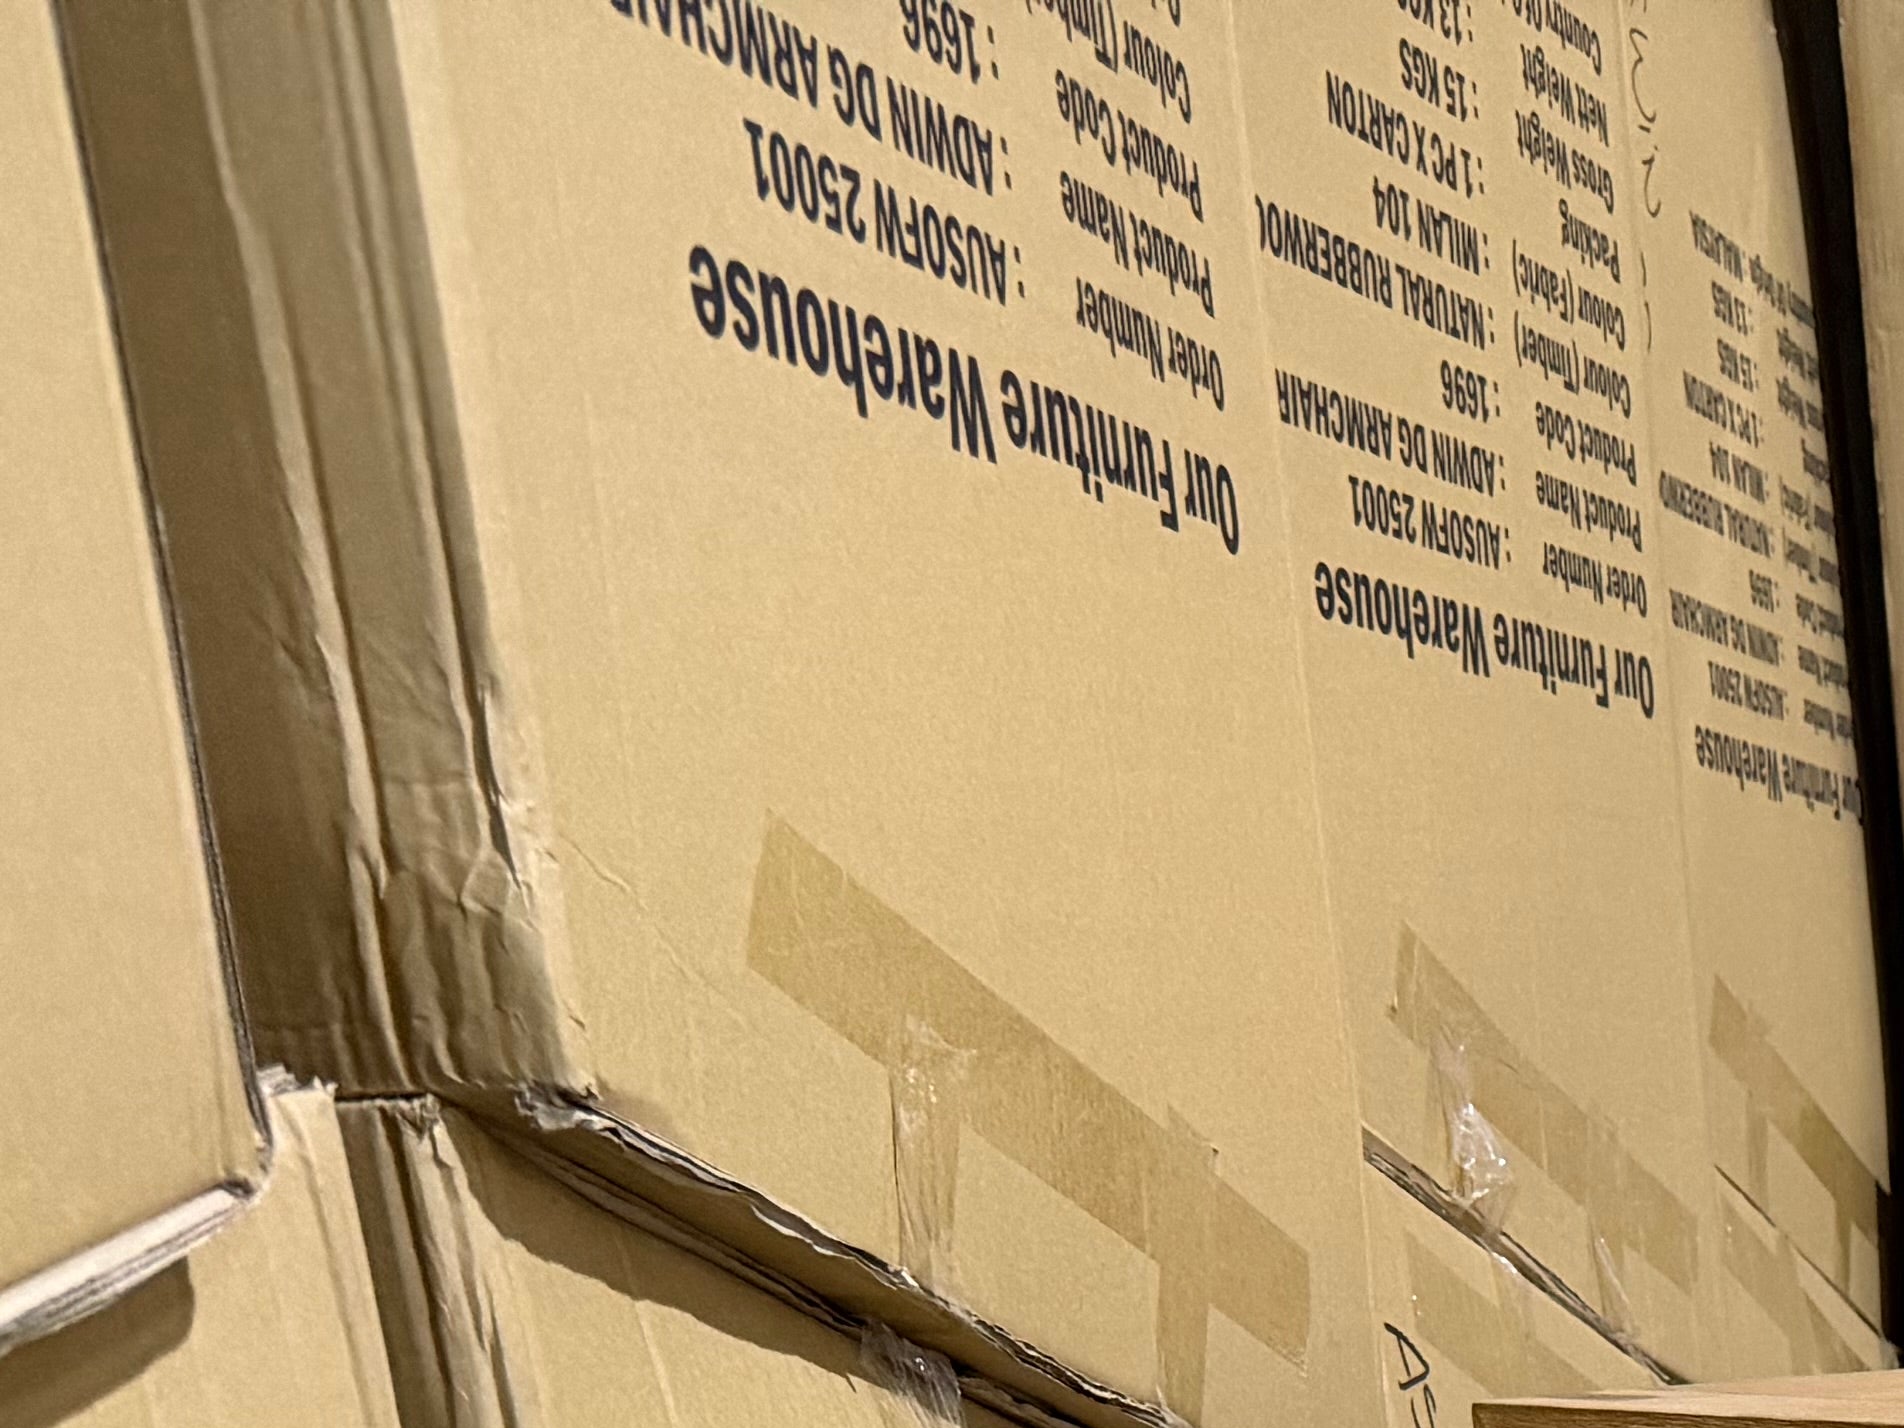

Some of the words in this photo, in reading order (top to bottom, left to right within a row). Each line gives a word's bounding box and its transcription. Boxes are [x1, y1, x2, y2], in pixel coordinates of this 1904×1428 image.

[826, 44, 883, 143] DG
[1122, 20, 1192, 125] Colour
[1398, 37, 1441, 108] KGS
[1443, 64, 1468, 123] 15
[885, 75, 993, 197] ADWIN
[1054, 68, 1117, 167] Code
[1325, 69, 1410, 165] CARTON
[1412, 120, 1429, 177] X
[1514, 109, 1572, 190] Weight
[1574, 82, 1610, 148] Nett
[742, 117, 867, 244] 25001
[1116, 109, 1204, 224] Product
[1430, 131, 1458, 192] PC
[1460, 147, 1474, 199] 1
[1571, 148, 1615, 215] Gross
[873, 178, 1007, 307] AUSOFW
[1059, 170, 1130, 271] Name
[1372, 175, 1412, 242] 104
[1416, 198, 1480, 276] MILAN
[1558, 197, 1621, 285] Packing
[1128, 210, 1216, 319] Product
[1512, 238, 1575, 325] (Fabric)
[1075, 276, 1166, 383] Number
[1394, 263, 1486, 351] NATURAL
[1577, 285, 1626, 352] Colour
[688, 244, 998, 465] Warehouse
[1167, 326, 1225, 412] Order
[1439, 359, 1490, 424] 1696
[1513, 309, 1580, 396] (Timber)
[1583, 355, 1631, 420] Colour
[999, 369, 1180, 533] Furniture
[1274, 367, 1393, 462] ARMCHAIR
[1396, 415, 1429, 475] DG
[1535, 401, 1576, 461] Code
[1577, 419, 1637, 487] Product
[1183, 448, 1240, 556] Our
[1430, 429, 1495, 498] ADWIN
[1535, 470, 1582, 531] Name
[1347, 474, 1417, 545] 25001
[1421, 499, 1501, 571] AUSOFW
[1582, 488, 1643, 553] Product
[1542, 541, 1604, 606] Number
[1605, 564, 1648, 618] Order
[1314, 561, 1491, 678] Warehouse
[1492, 612, 1610, 709] Furniture
[1613, 648, 1655, 720] Our
